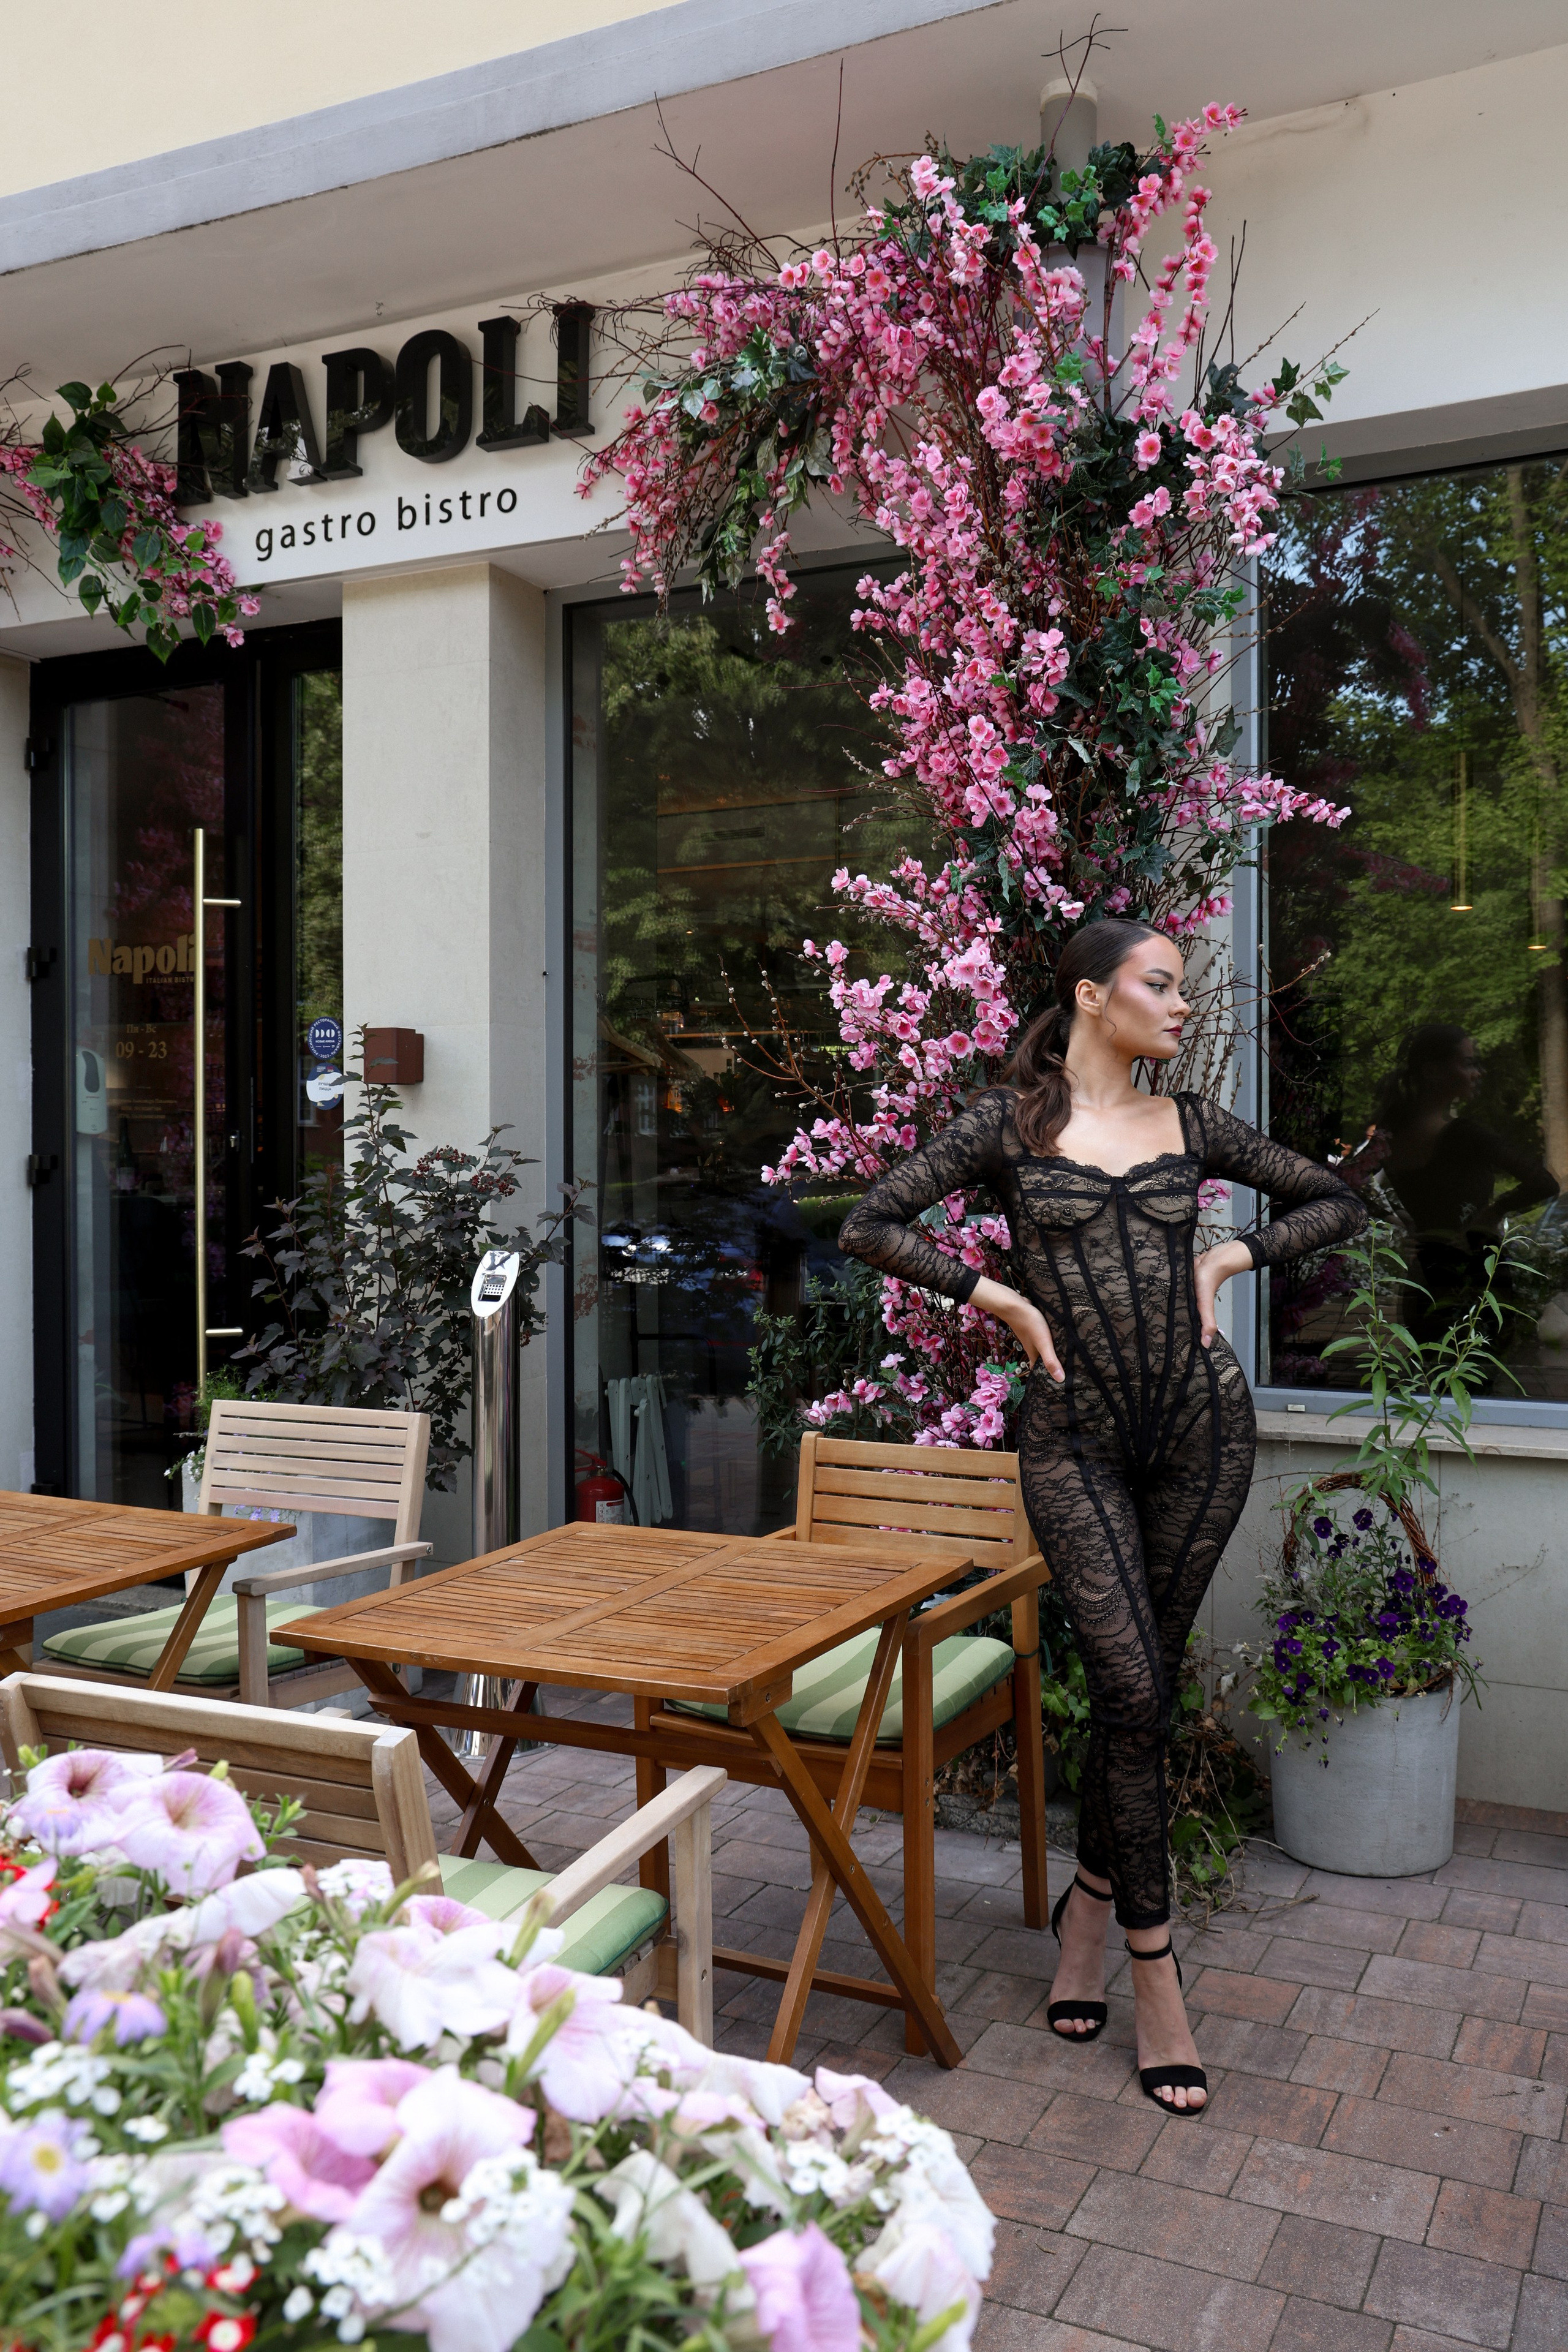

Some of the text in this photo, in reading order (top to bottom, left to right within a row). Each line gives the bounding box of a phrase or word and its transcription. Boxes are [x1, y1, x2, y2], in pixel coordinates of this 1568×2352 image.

[173, 301, 595, 505] NAPOLI
[255, 488, 518, 562] gastro bistro
[88, 933, 195, 984] Napoli
[115, 1041, 135, 1058] 09
[148, 1041, 168, 1058] 23
[126, 1024, 139, 1033] Пн
[146, 1023, 157, 1033] Вс
